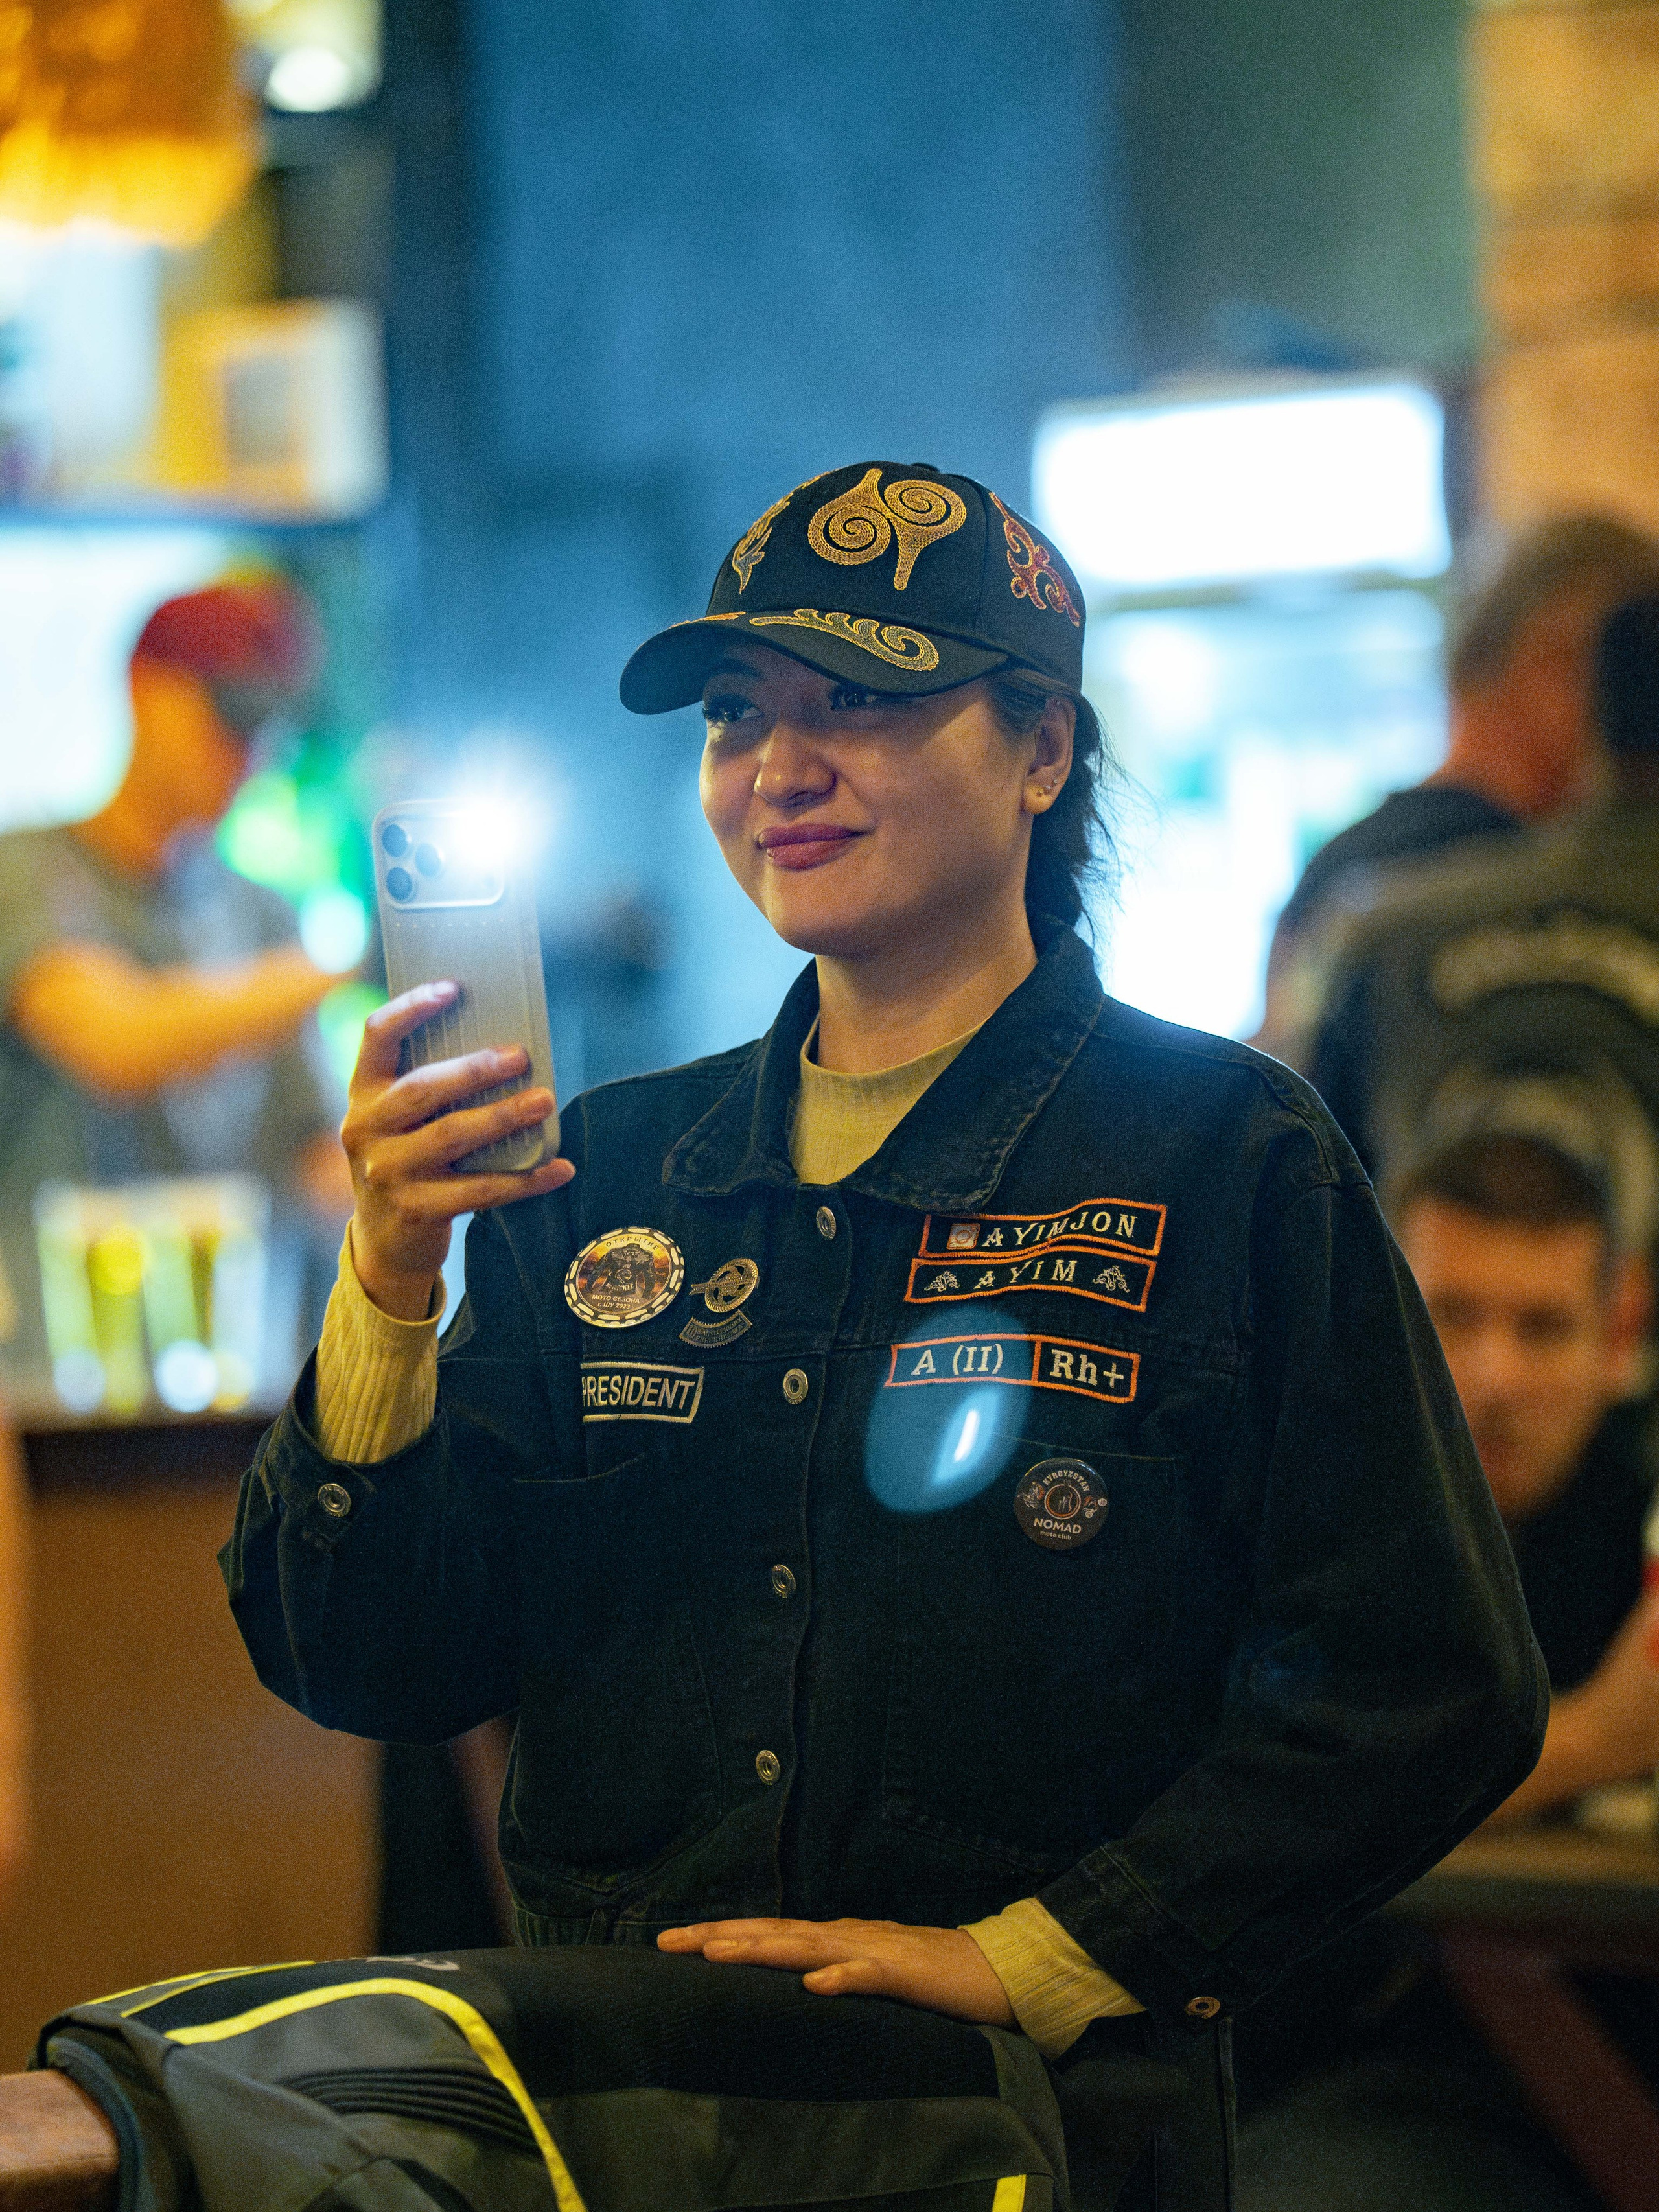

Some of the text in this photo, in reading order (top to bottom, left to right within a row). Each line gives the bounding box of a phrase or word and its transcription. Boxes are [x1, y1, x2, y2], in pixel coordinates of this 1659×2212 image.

[981, 1211, 1138, 1247] AYIMJON
[605, 1236, 660, 1251] ОТКРЫТИЕ
[973, 1259, 1078, 1290] AYIM
[910, 1349, 936, 1376] A
[1050, 1349, 1125, 1389] Rh+
[1042, 1469, 1091, 1492] KYRGYZSTAN
[1034, 1518, 1082, 1533] NOMAD
